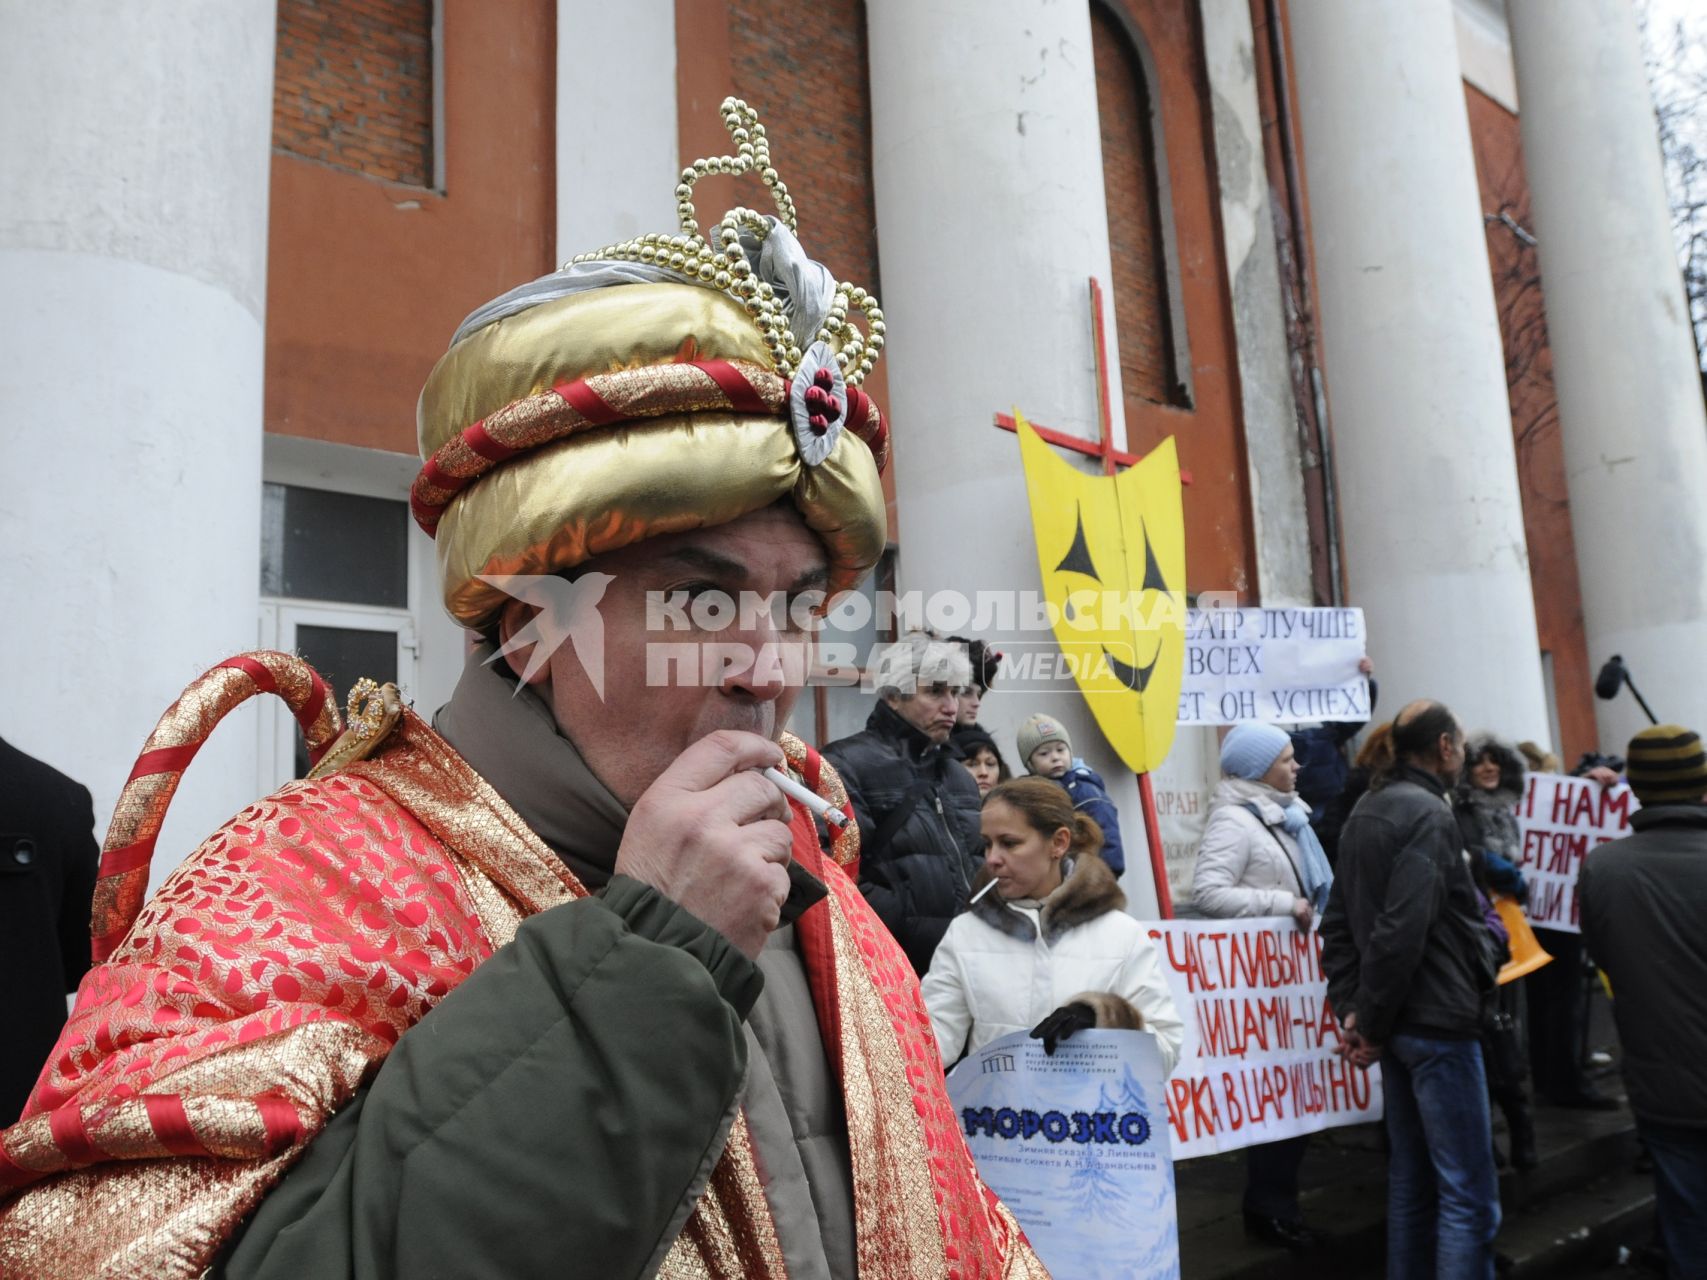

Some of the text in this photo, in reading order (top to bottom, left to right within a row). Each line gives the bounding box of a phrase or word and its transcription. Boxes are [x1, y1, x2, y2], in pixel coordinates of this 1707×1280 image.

[1185, 610, 1358, 640] ЕАТР ЛУЧШЕ
[1189, 645, 1264, 675] ВСЕХ
[1177, 681, 1368, 721] ЕТ ОН УСПЕХ!
[1157, 791, 1198, 815] ОРАН
[1552, 782, 1629, 830] НАМ
[1524, 830, 1588, 875] ЕТЯМ
[1148, 930, 1327, 993] ЧАСТЛИВЫМ
[1241, 1057, 1371, 1129] ЦАРИЦЫНО
[962, 1106, 1151, 1145] МОРОЗКО
